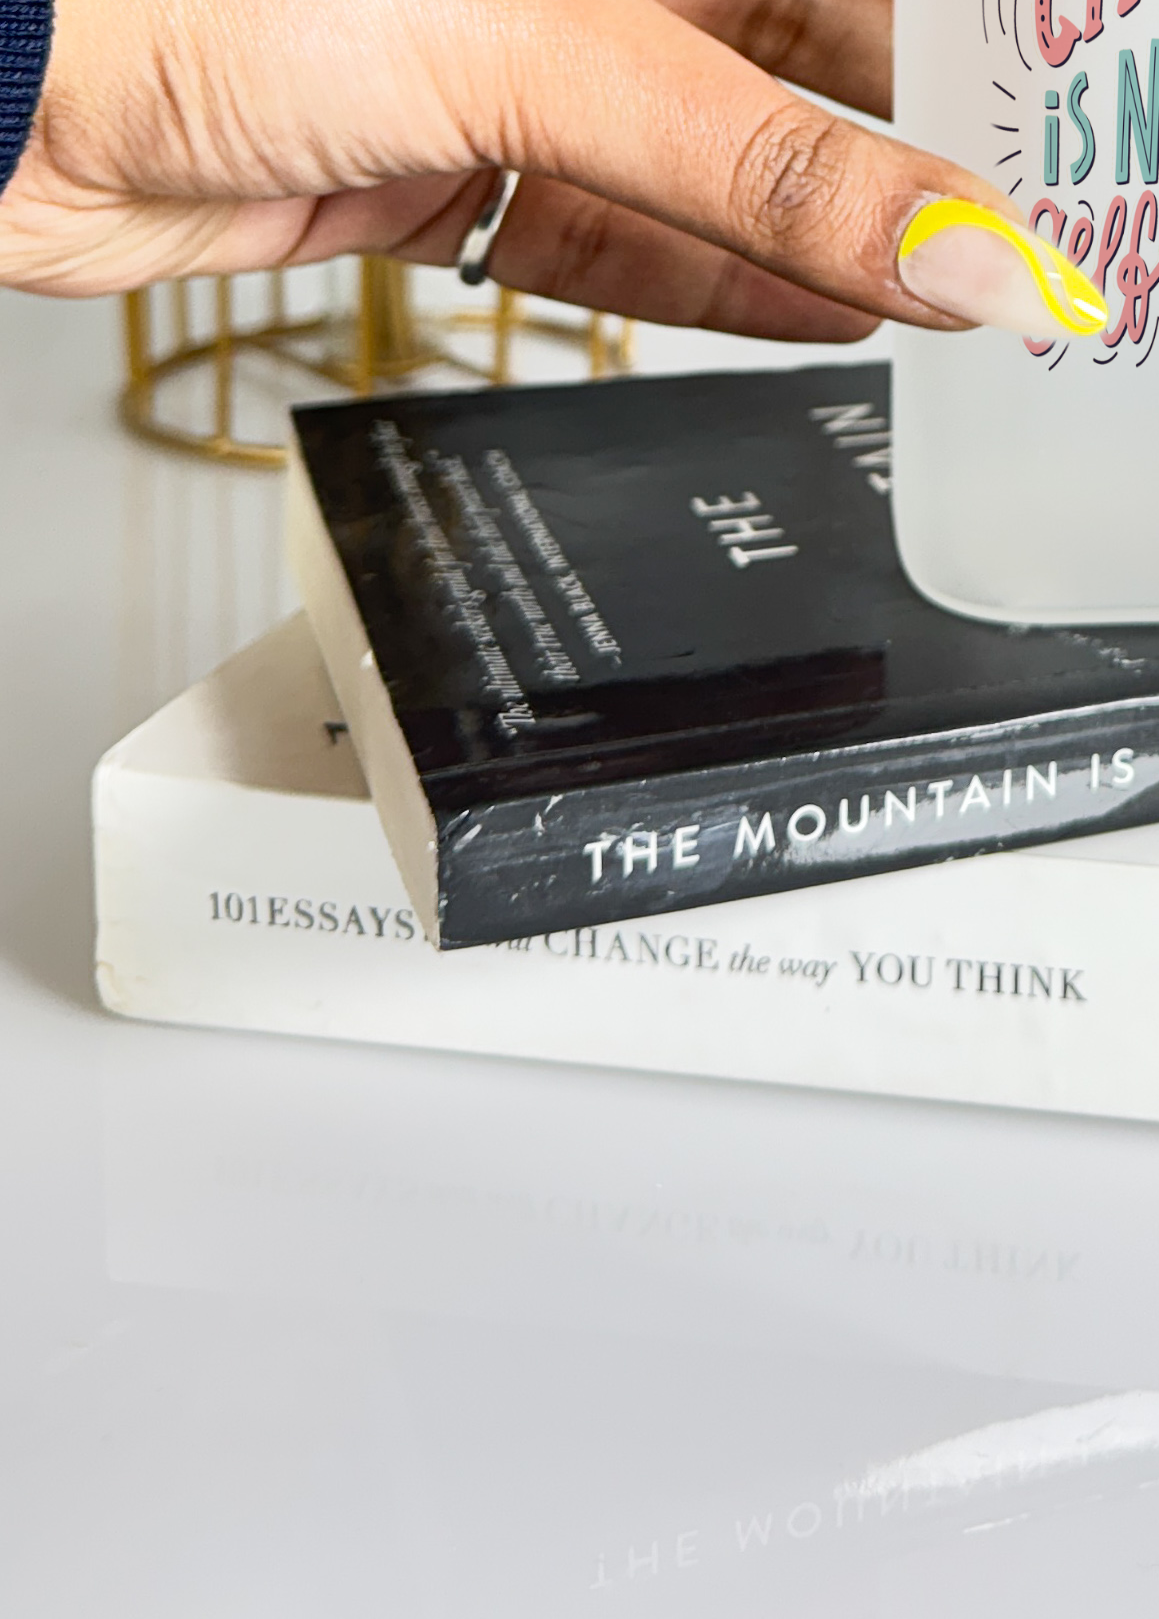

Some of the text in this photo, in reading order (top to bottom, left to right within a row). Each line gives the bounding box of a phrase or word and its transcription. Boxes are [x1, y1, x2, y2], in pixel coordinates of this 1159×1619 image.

[690, 491, 798, 569] THE
[578, 612, 622, 654] JENNA
[584, 824, 700, 883] THE
[733, 760, 1058, 860] MOUNTAIN
[1090, 747, 1135, 789] IS
[542, 928, 720, 971] CHANGE
[728, 943, 770, 976] the
[778, 956, 839, 989] way
[849, 950, 937, 988] YOU
[945, 957, 1088, 1003] THINK
